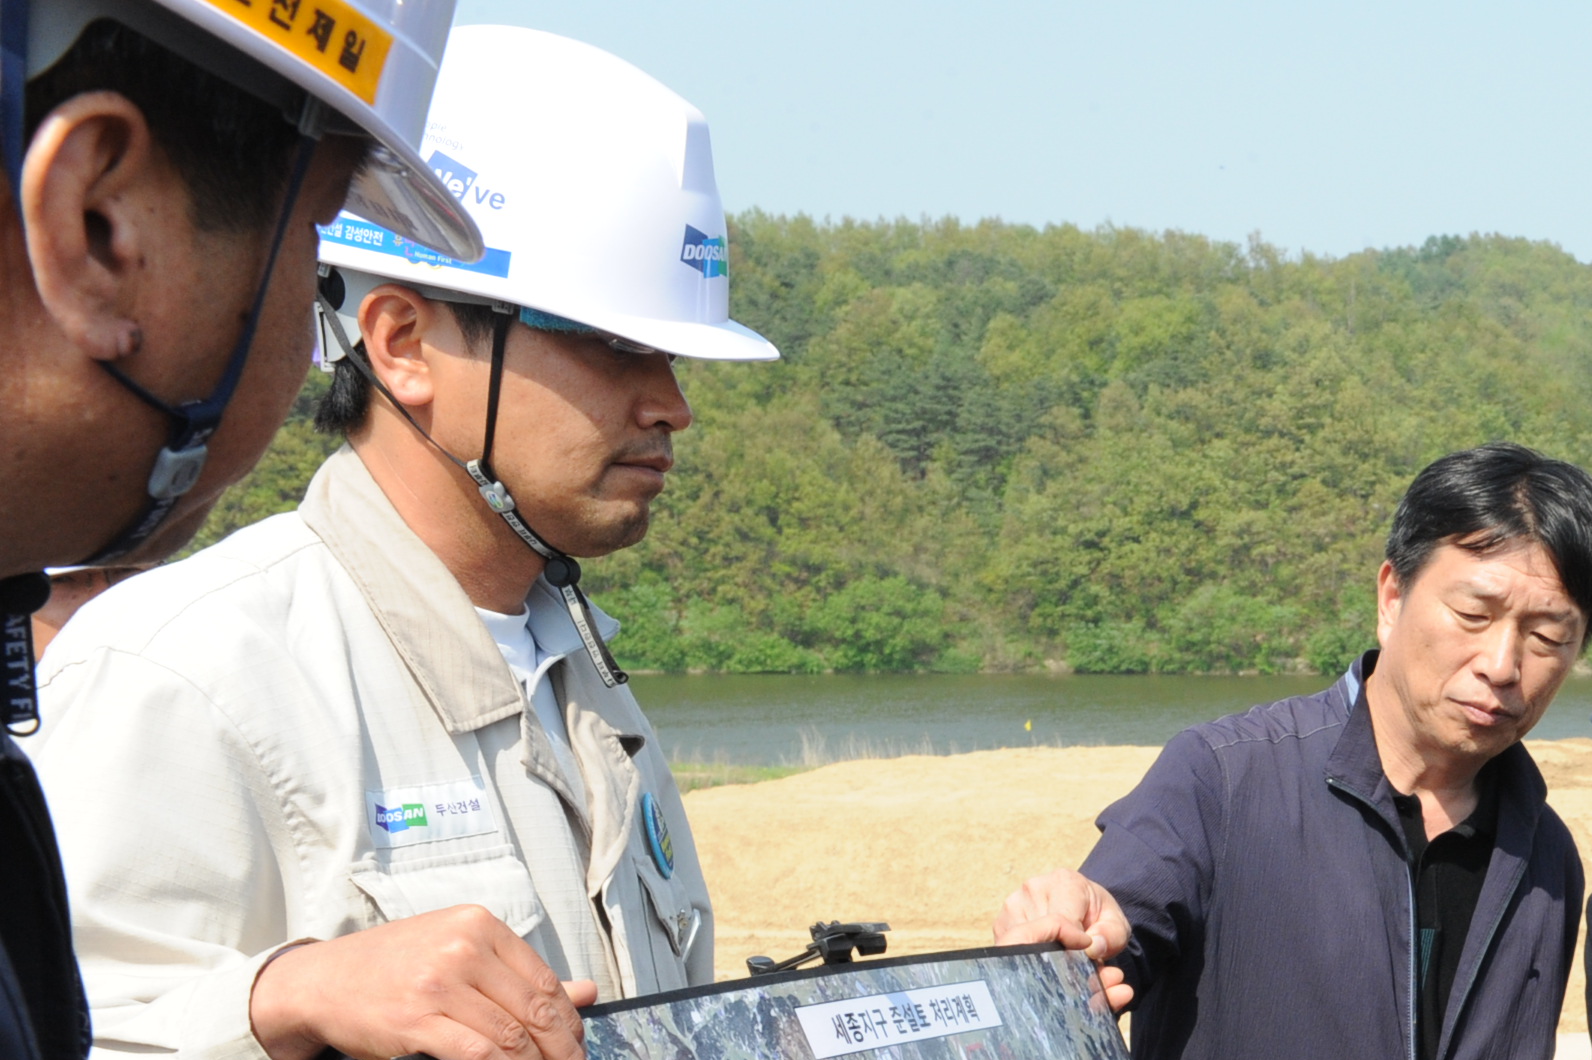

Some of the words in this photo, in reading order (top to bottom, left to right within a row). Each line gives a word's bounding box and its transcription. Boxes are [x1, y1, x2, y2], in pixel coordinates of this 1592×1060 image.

[235, 0, 366, 74] 전제일
[345, 225, 384, 247] 감성안전
[414, 251, 436, 261] Human
[437, 255, 453, 265] First
[682, 244, 726, 262] DOOSA
[4, 614, 31, 690] AFETY
[10, 697, 34, 719] FI
[435, 798, 481, 817] 두산건설
[830, 1008, 889, 1045] 세종지구
[889, 1000, 932, 1035] 준설토
[929, 992, 981, 1028] 처리계획
